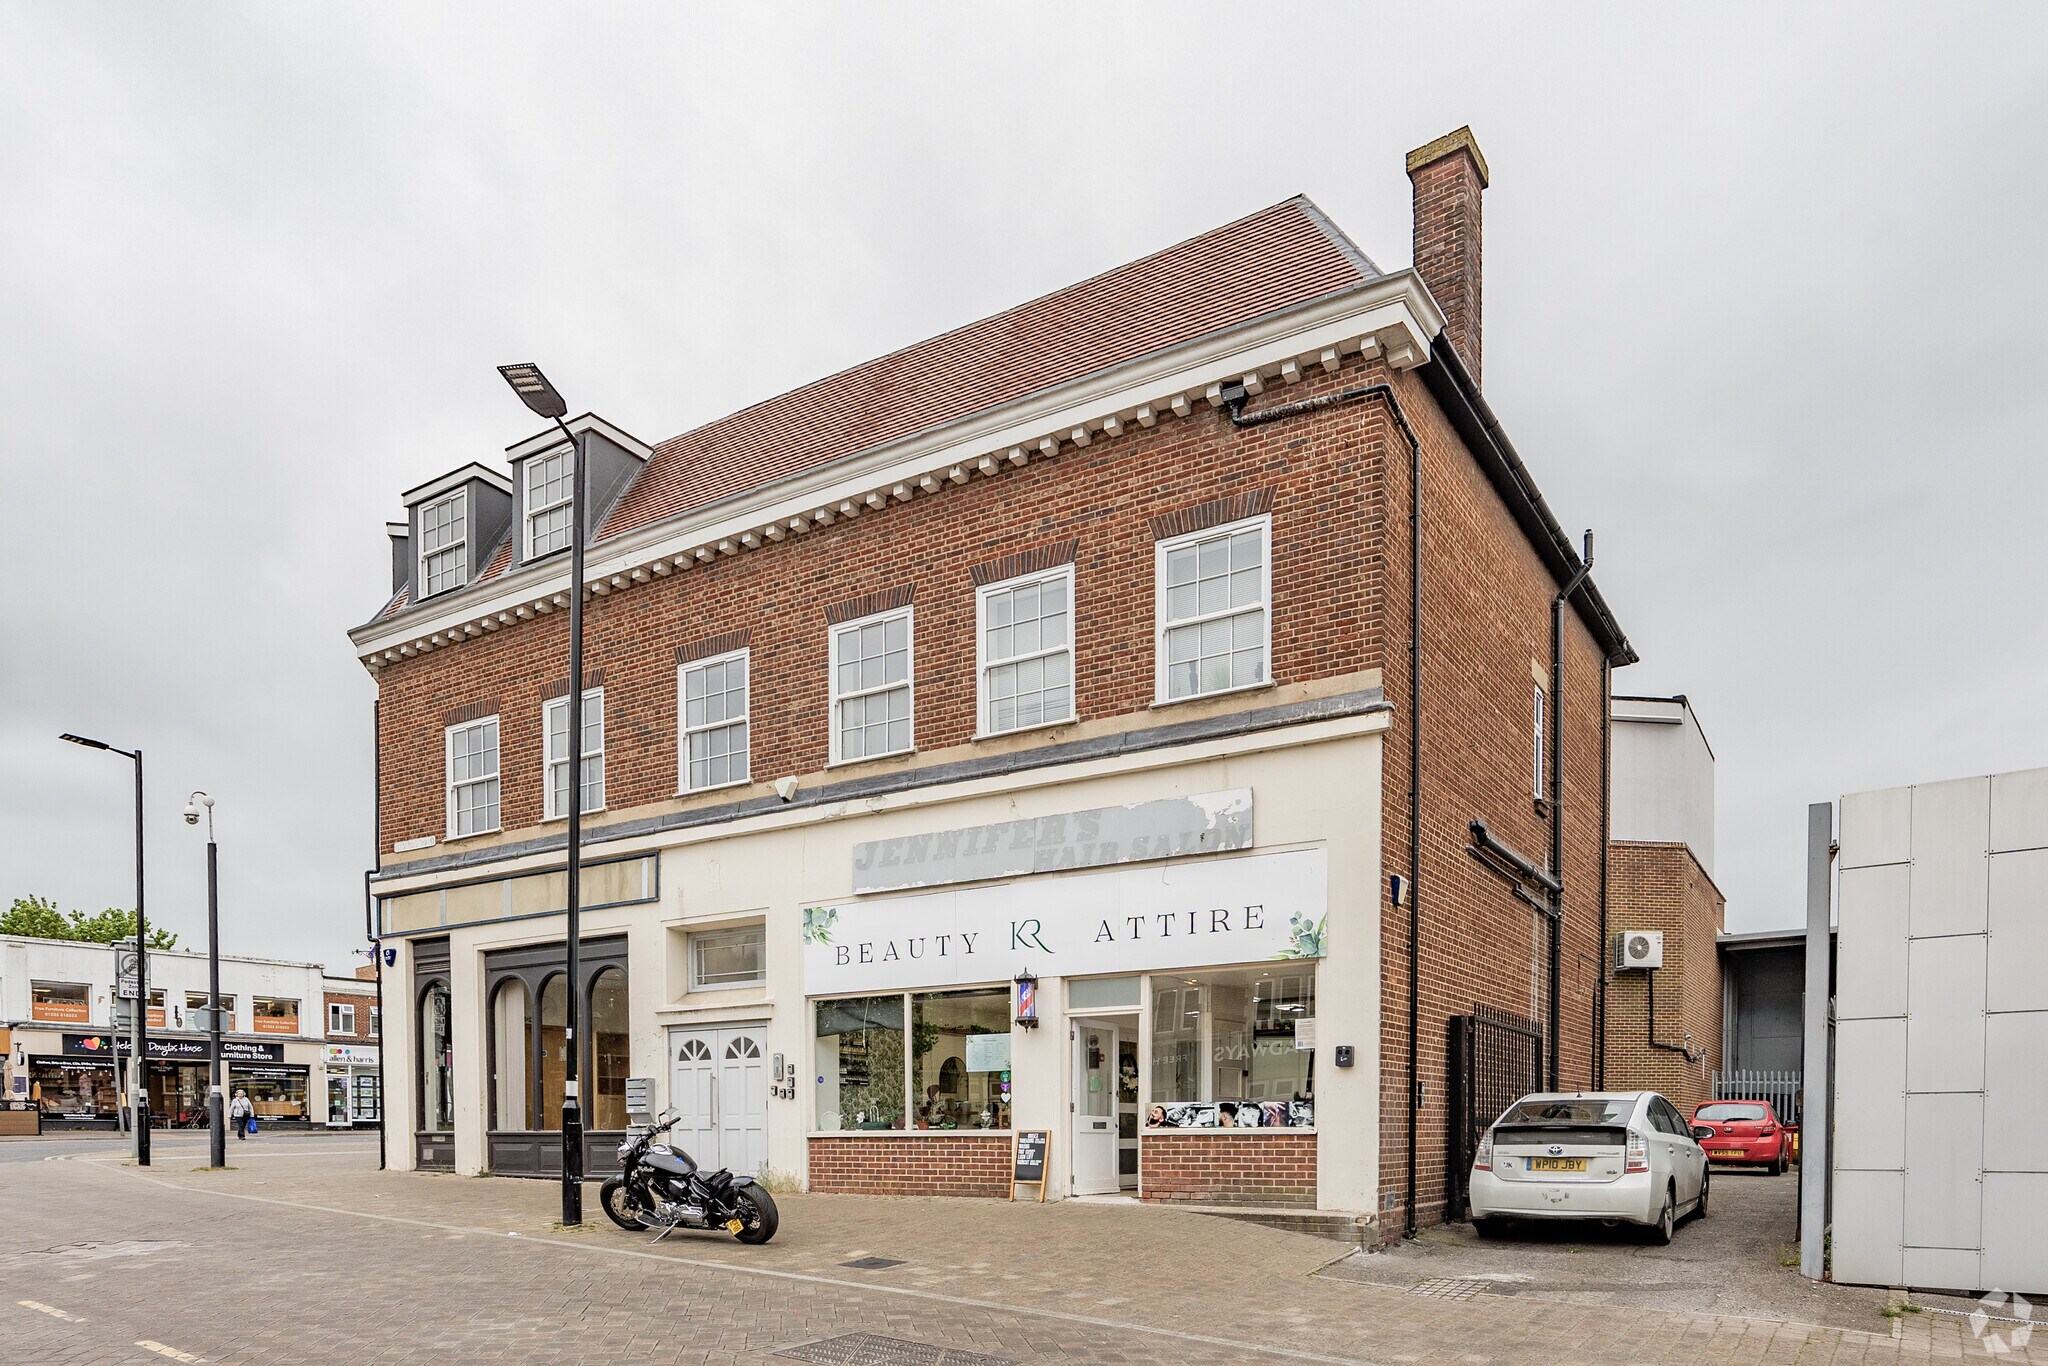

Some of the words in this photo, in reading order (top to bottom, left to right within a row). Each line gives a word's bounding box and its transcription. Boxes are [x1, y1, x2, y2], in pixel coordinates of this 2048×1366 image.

[855, 810, 1101, 871] JENNIFER'S
[835, 932, 979, 966] BEAUTY
[1010, 919, 1056, 954] KR
[1093, 904, 1265, 943] ATTIRE
[147, 1041, 178, 1057] Douglas
[178, 1042, 203, 1053] House
[224, 1043, 257, 1053] Clothing
[220, 1051, 251, 1059] urniture
[252, 1052, 273, 1060] Store
[329, 1054, 346, 1062] allen
[353, 1055, 374, 1063] harris
[1535, 1159, 1559, 1170] WP10
[1561, 1160, 1582, 1170] JBY
